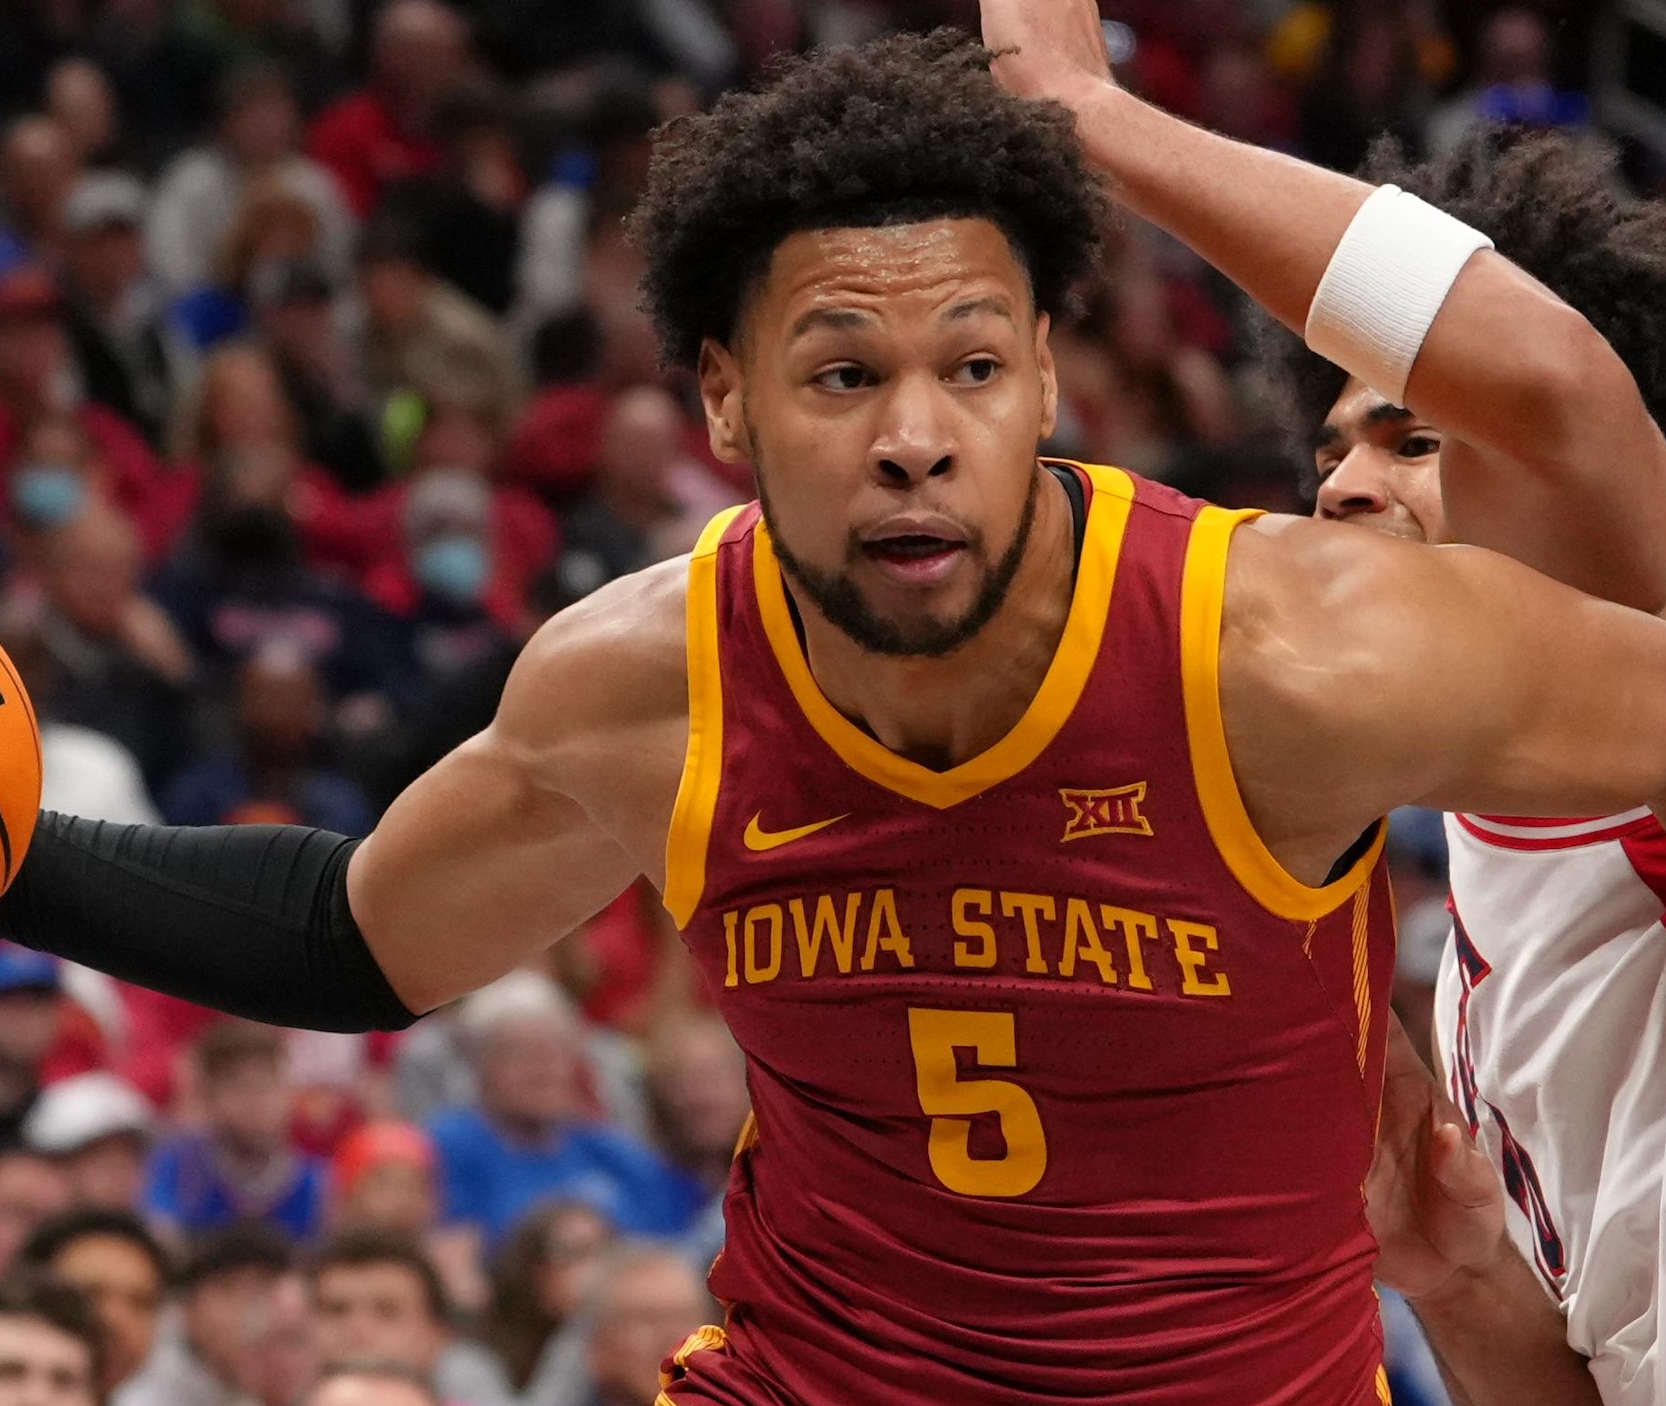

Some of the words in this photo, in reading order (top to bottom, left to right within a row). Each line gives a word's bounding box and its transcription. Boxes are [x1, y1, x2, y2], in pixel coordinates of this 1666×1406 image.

[722, 888, 914, 988] IOWA
[951, 888, 1232, 997] STATE
[908, 1006, 1047, 1198] 5
